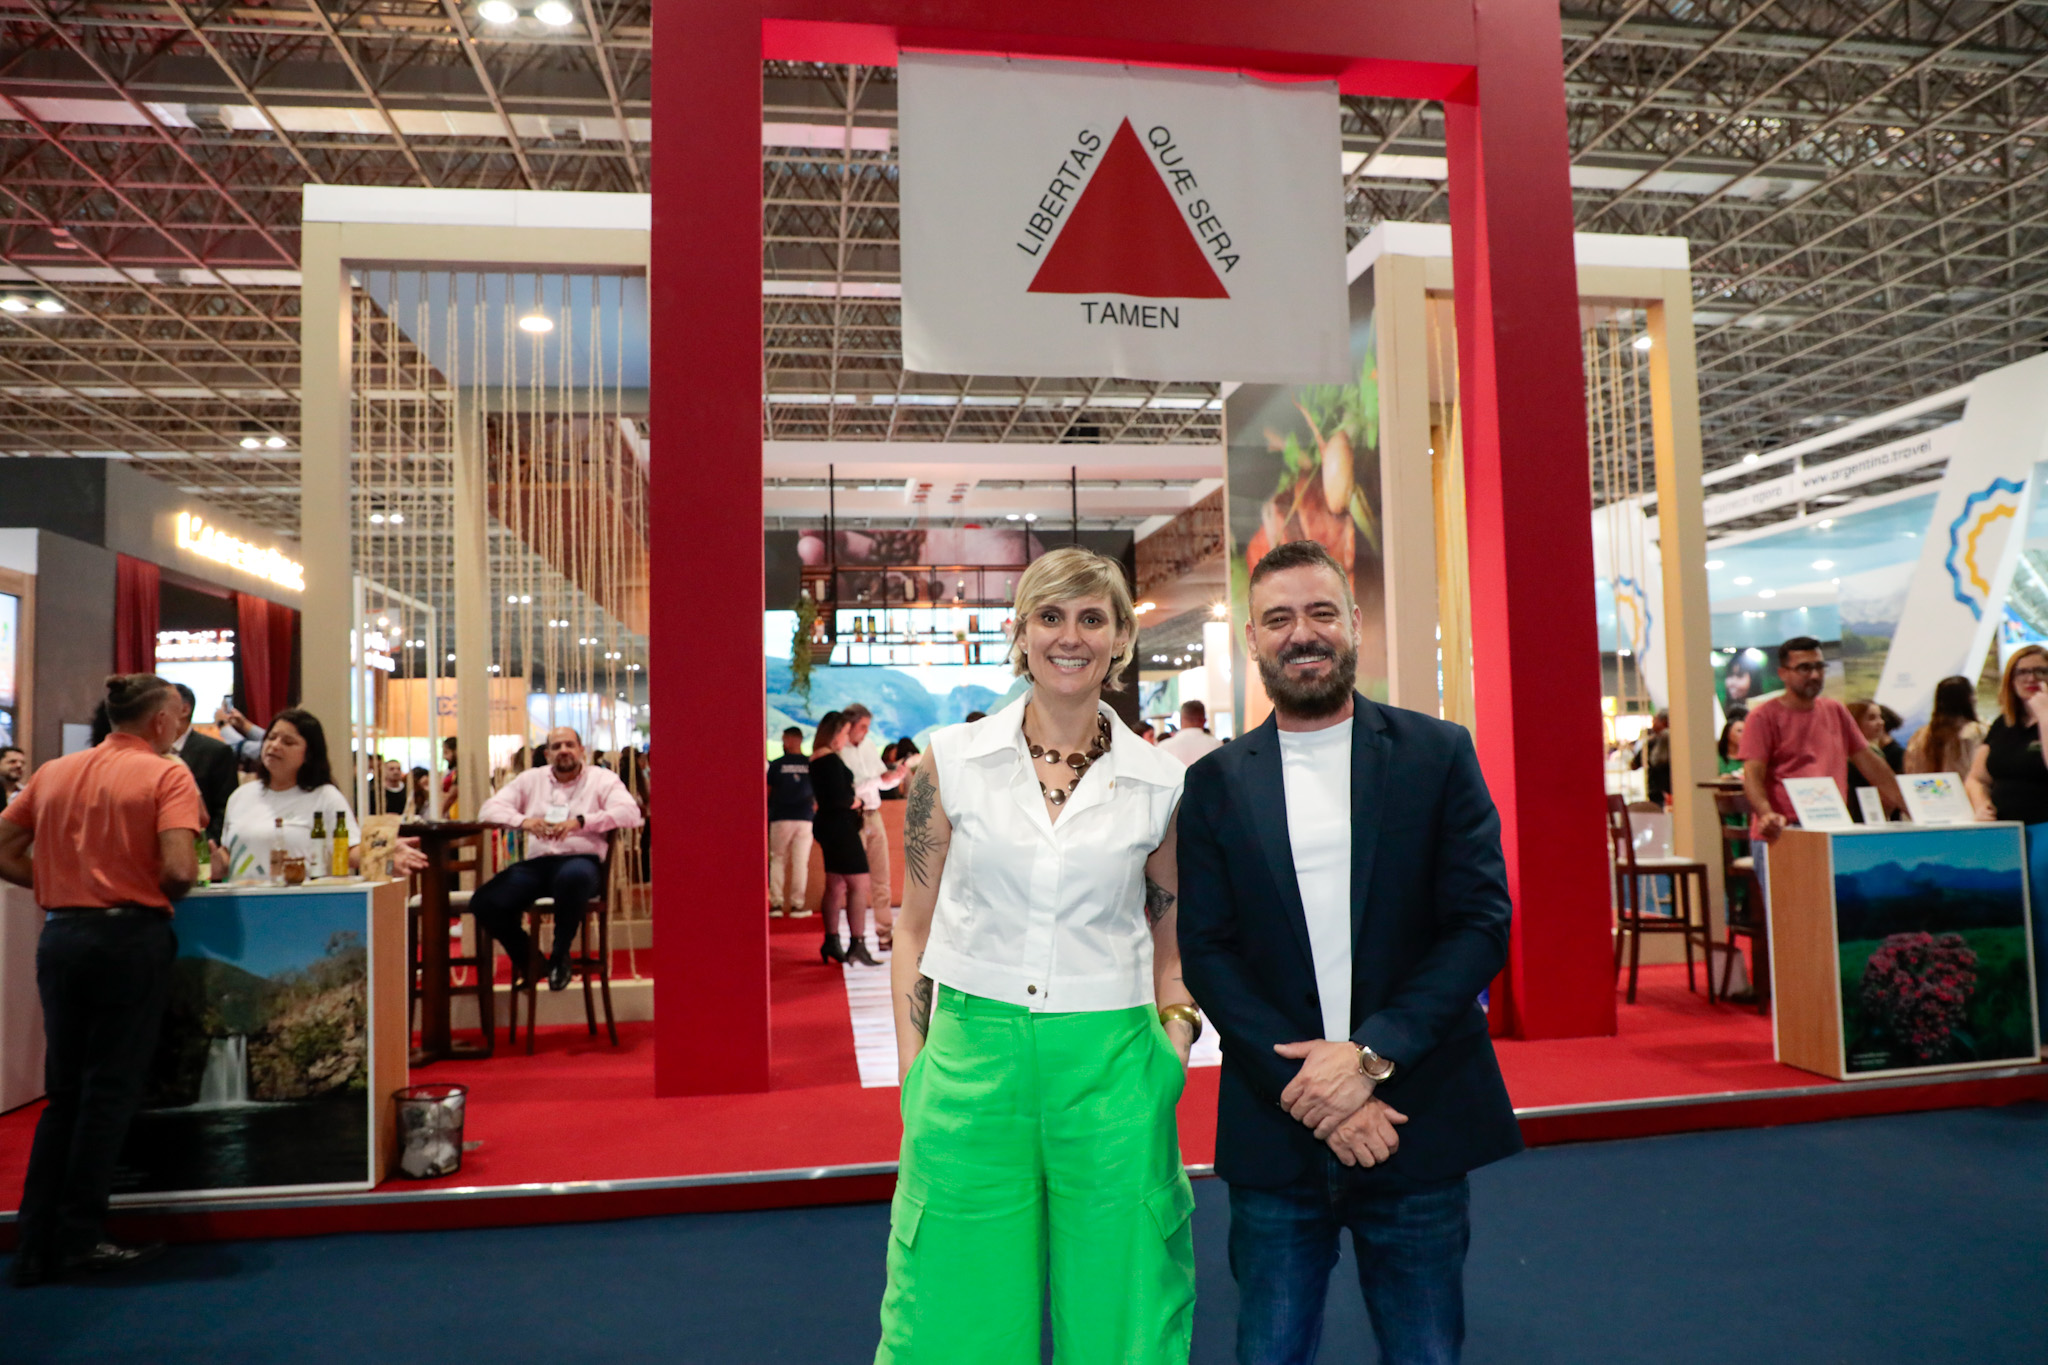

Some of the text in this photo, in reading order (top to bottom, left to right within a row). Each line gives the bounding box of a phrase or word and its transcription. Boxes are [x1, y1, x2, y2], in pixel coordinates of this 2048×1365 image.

[1016, 128, 1101, 257] LIBERTAS
[1148, 125, 1241, 274] QUÆ SERA
[1080, 301, 1180, 329] TAMEN
